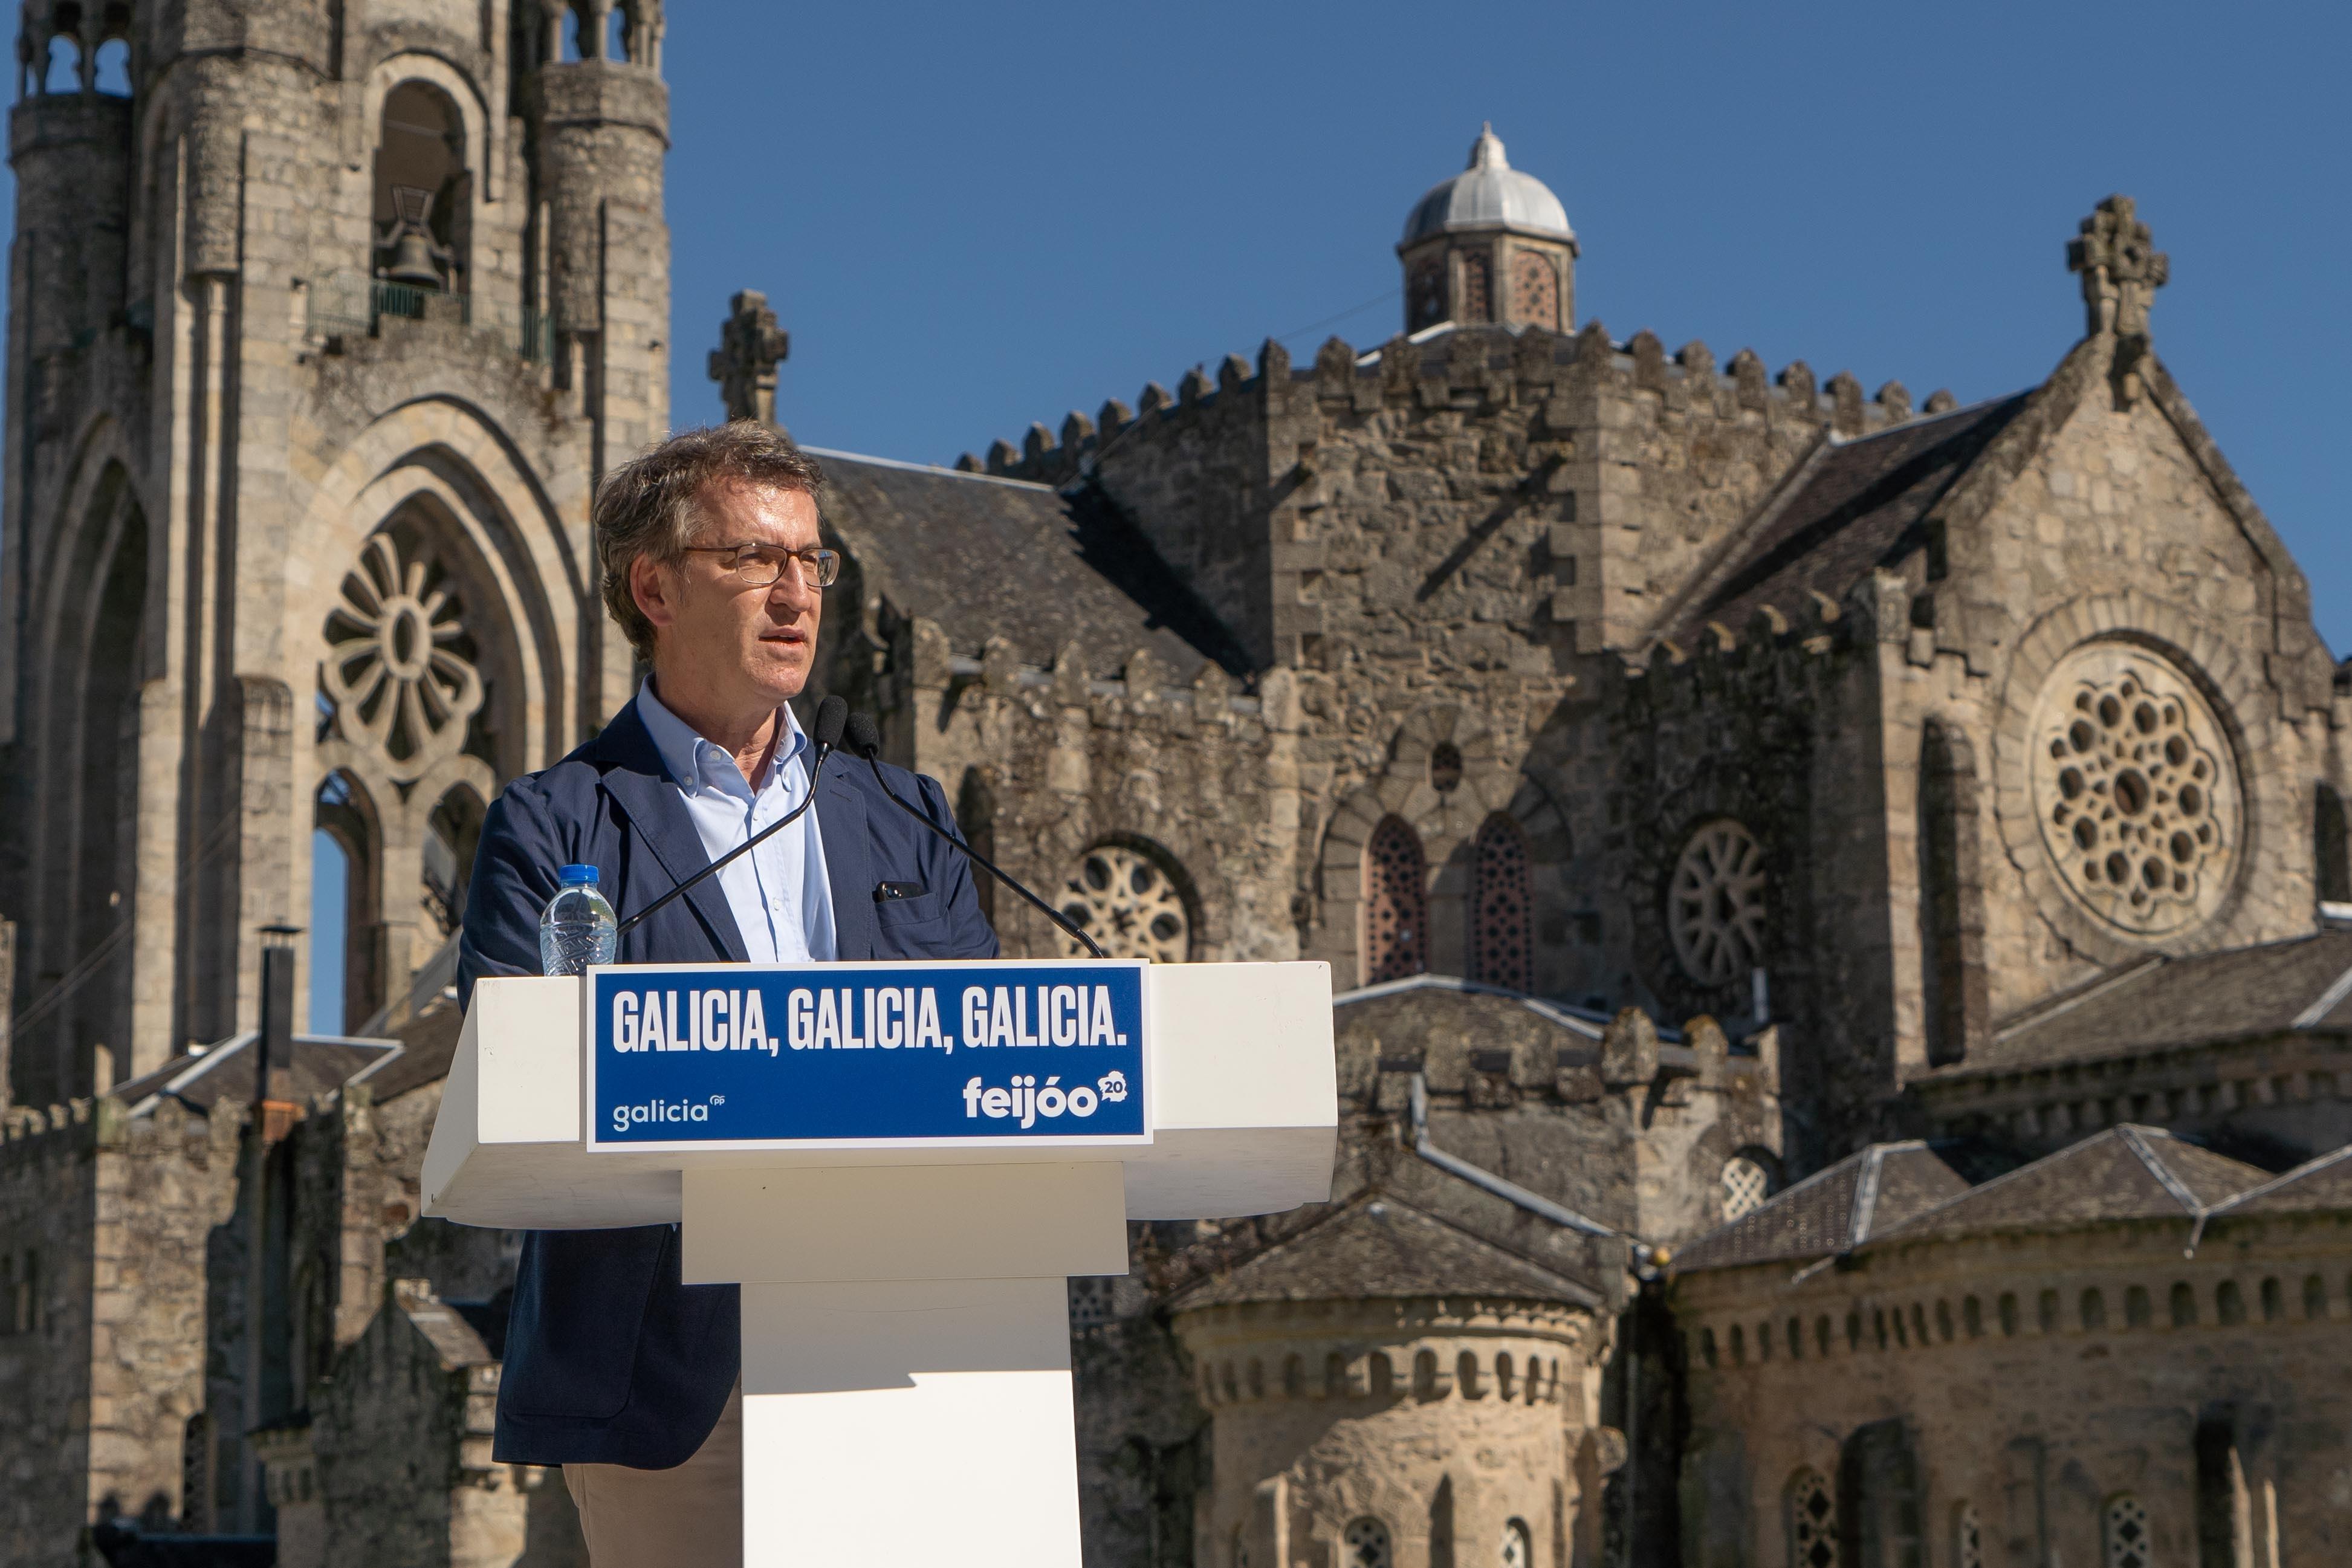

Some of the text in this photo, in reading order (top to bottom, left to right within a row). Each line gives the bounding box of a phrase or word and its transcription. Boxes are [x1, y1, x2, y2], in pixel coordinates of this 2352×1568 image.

[613, 985, 1127, 1057] GALICIA, GALICIA, GALICIA.
[613, 1099, 708, 1132] galicia
[962, 1076, 1123, 1129] feijóo 20
